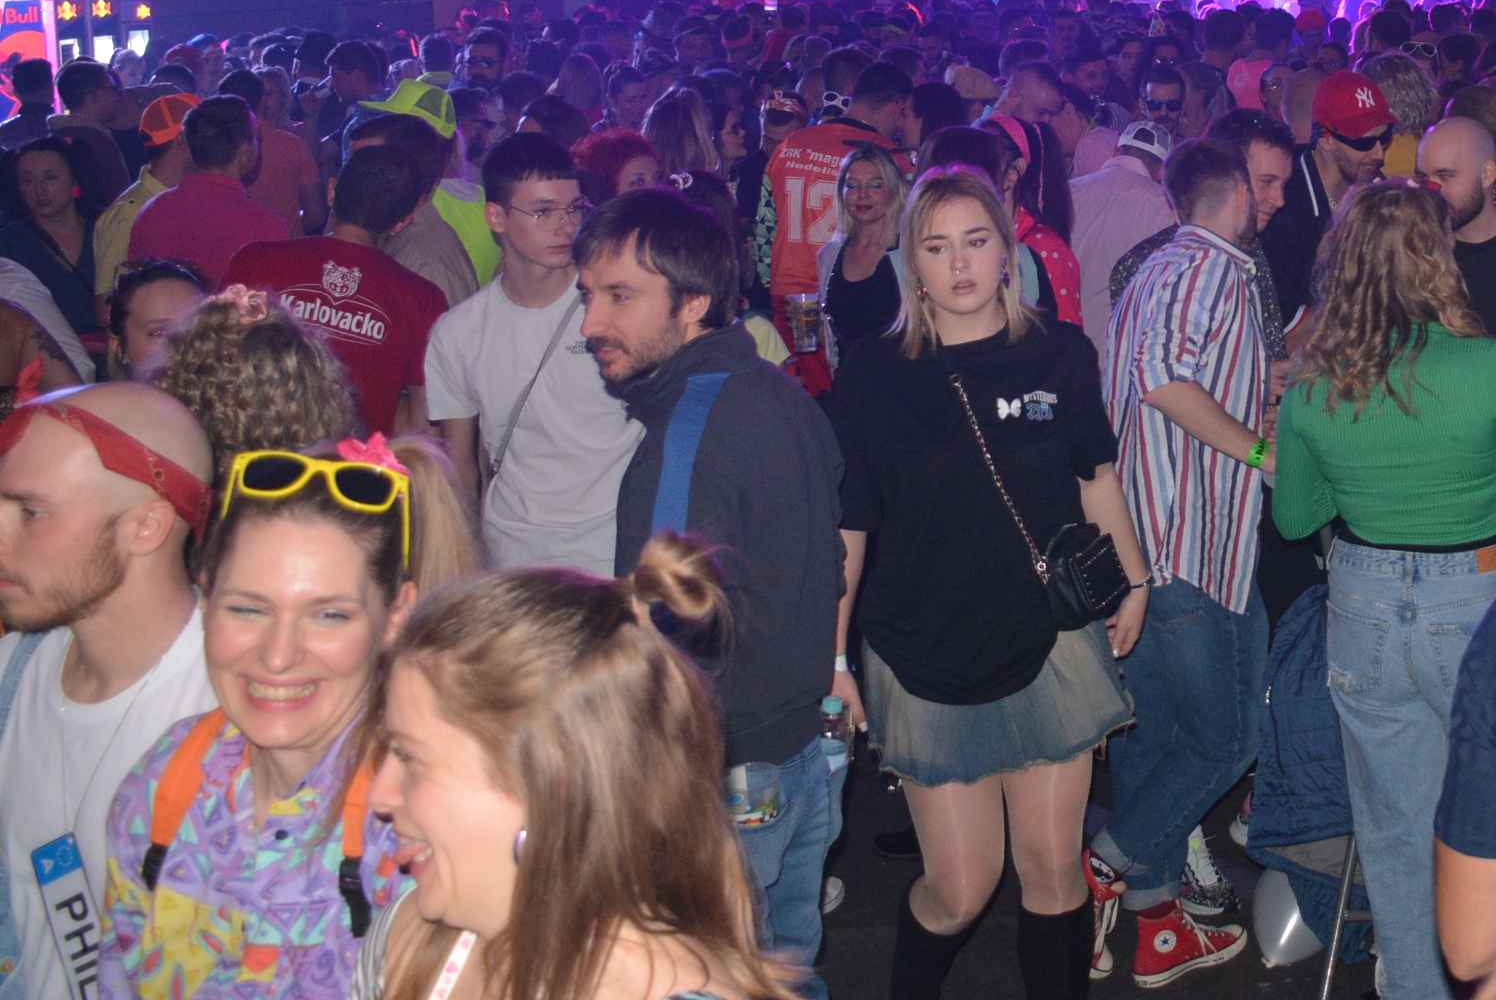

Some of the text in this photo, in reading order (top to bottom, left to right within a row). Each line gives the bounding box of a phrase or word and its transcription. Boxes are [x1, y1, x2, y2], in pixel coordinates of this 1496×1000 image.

[5, 6, 38, 24] Bull
[784, 176, 838, 245] 12
[279, 293, 386, 340] Karlovačko
